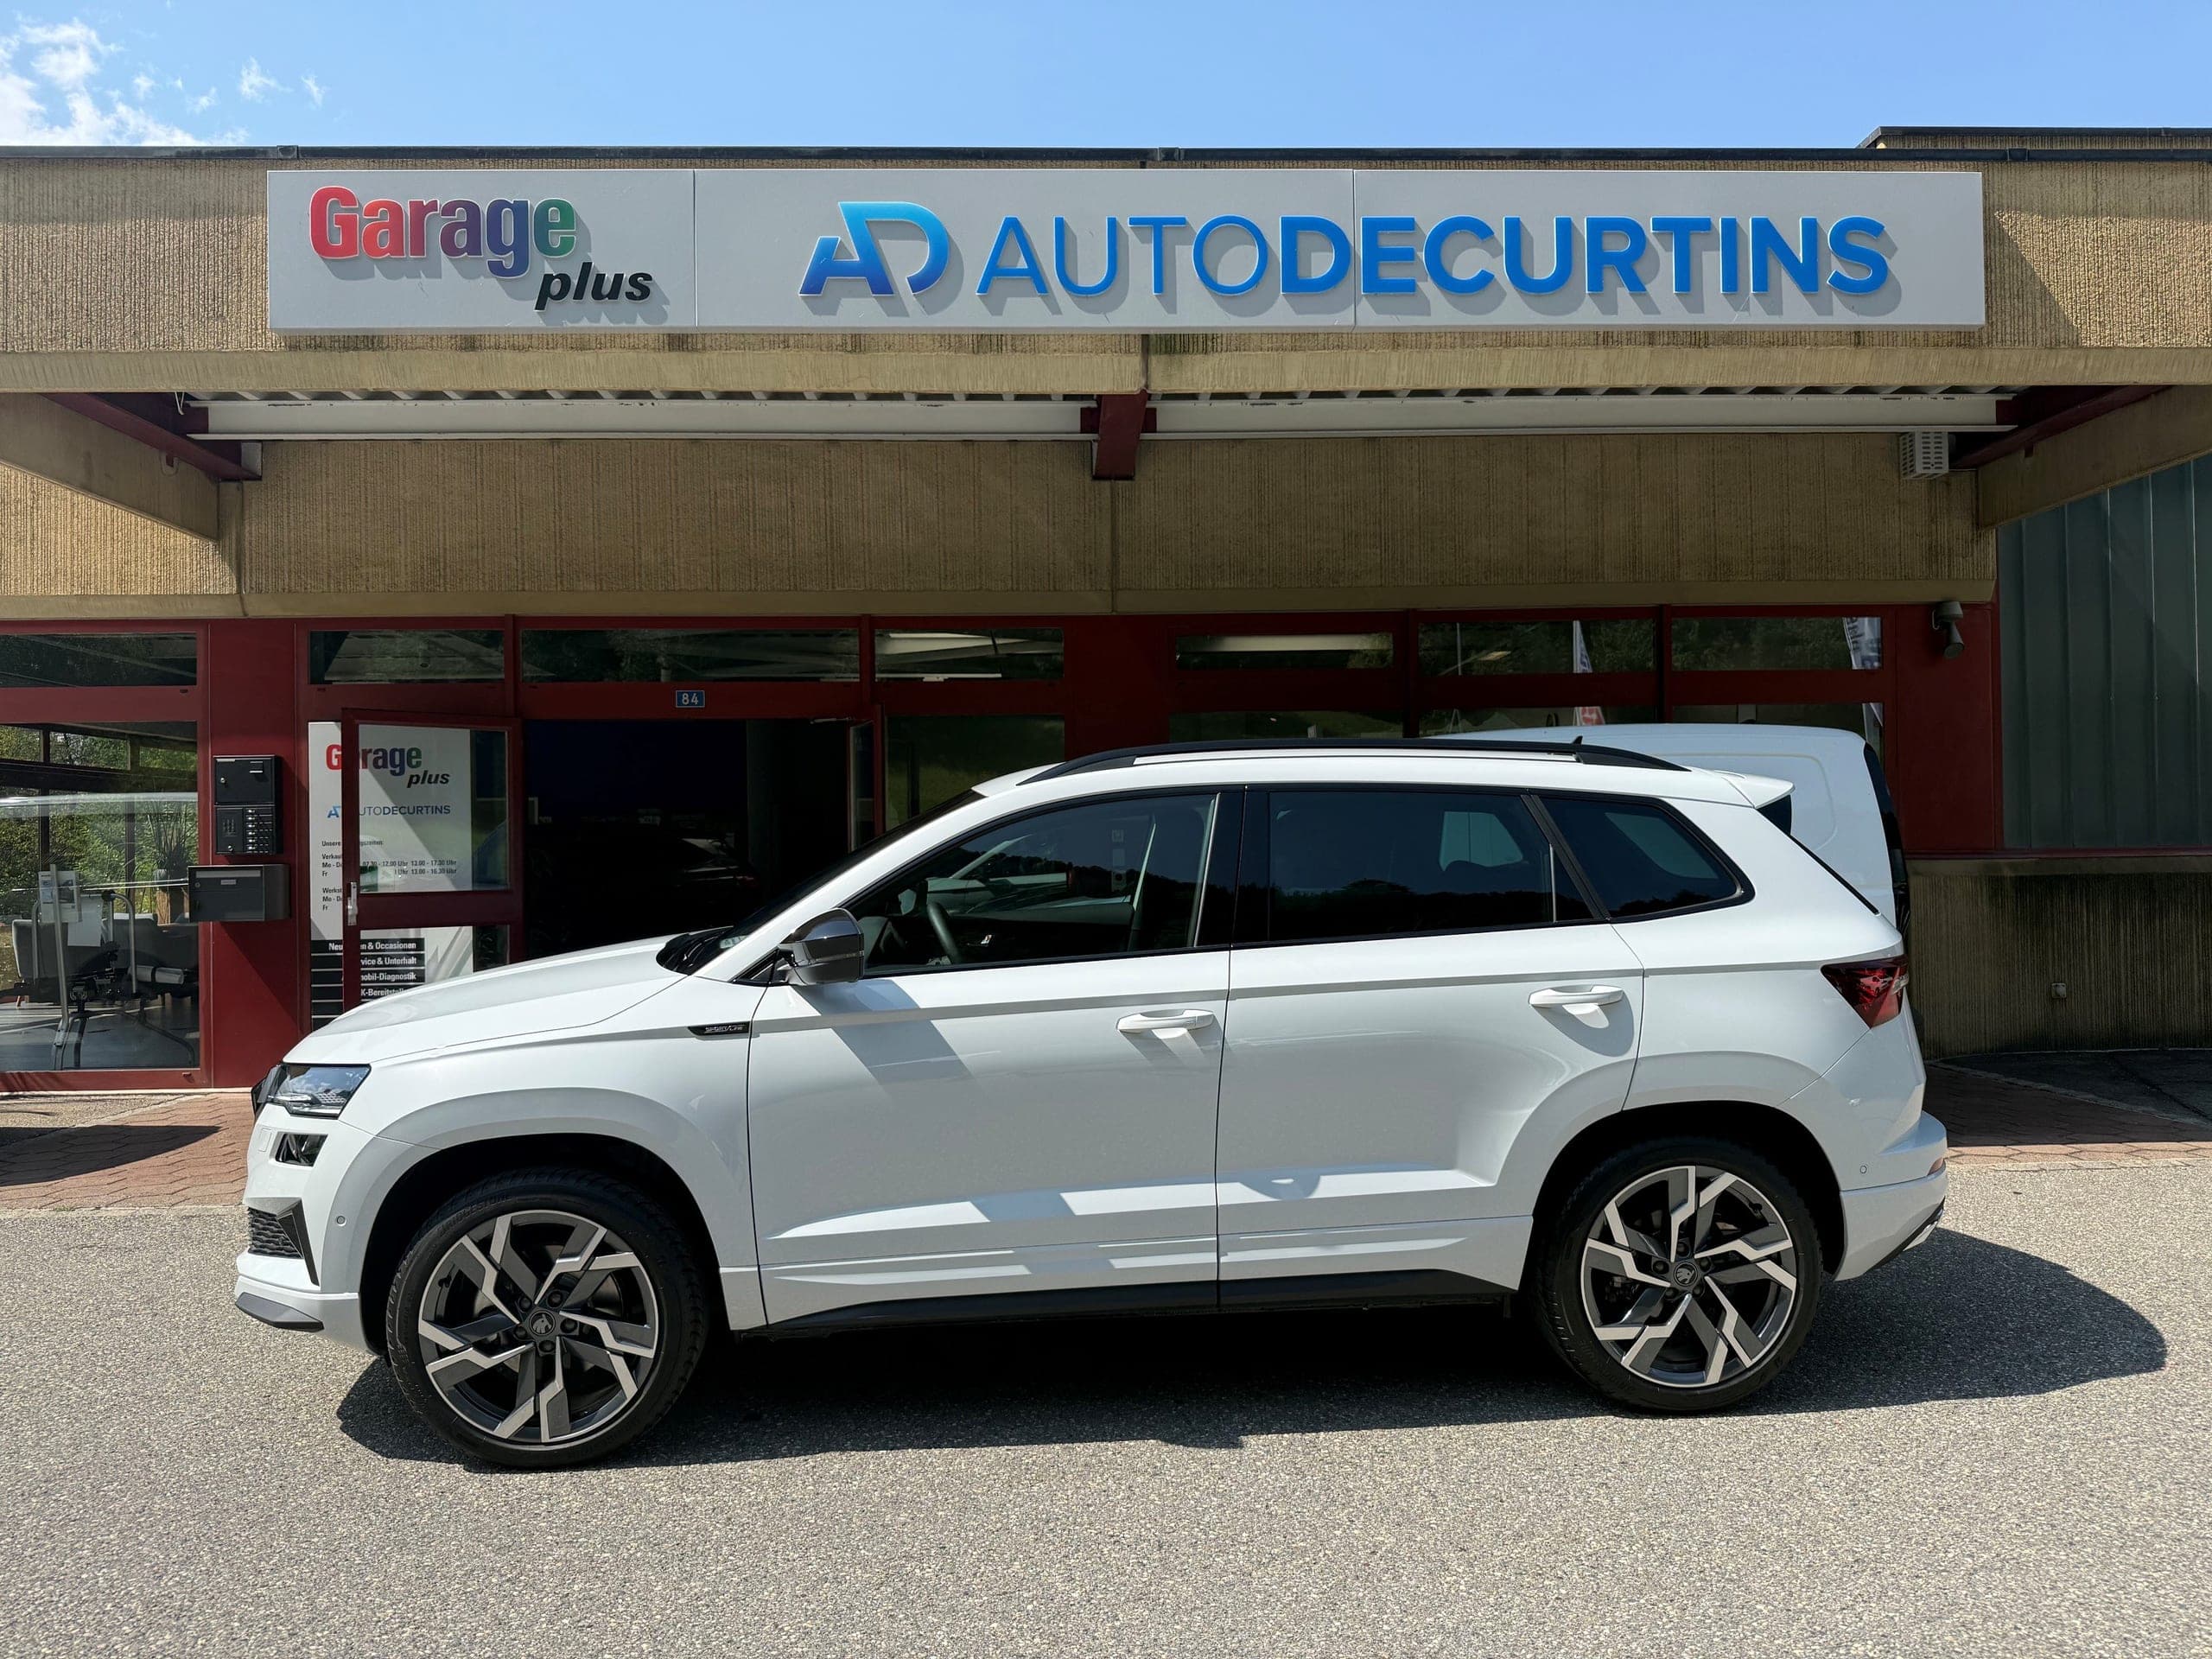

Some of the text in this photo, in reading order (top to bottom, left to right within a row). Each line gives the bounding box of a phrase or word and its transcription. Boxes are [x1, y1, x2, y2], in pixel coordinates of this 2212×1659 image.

[309, 185, 576, 279] Garage
[974, 213, 1891, 298] AUTODECURTINS
[534, 261, 653, 312] plus
[682, 692, 699, 705] 84
[326, 743, 423, 777] Grage
[406, 769, 451, 789] plus
[359, 804, 451, 817] UTODECURTINS
[375, 940, 416, 950] Occasionen
[359, 956, 417, 966] vice & Unterhalt
